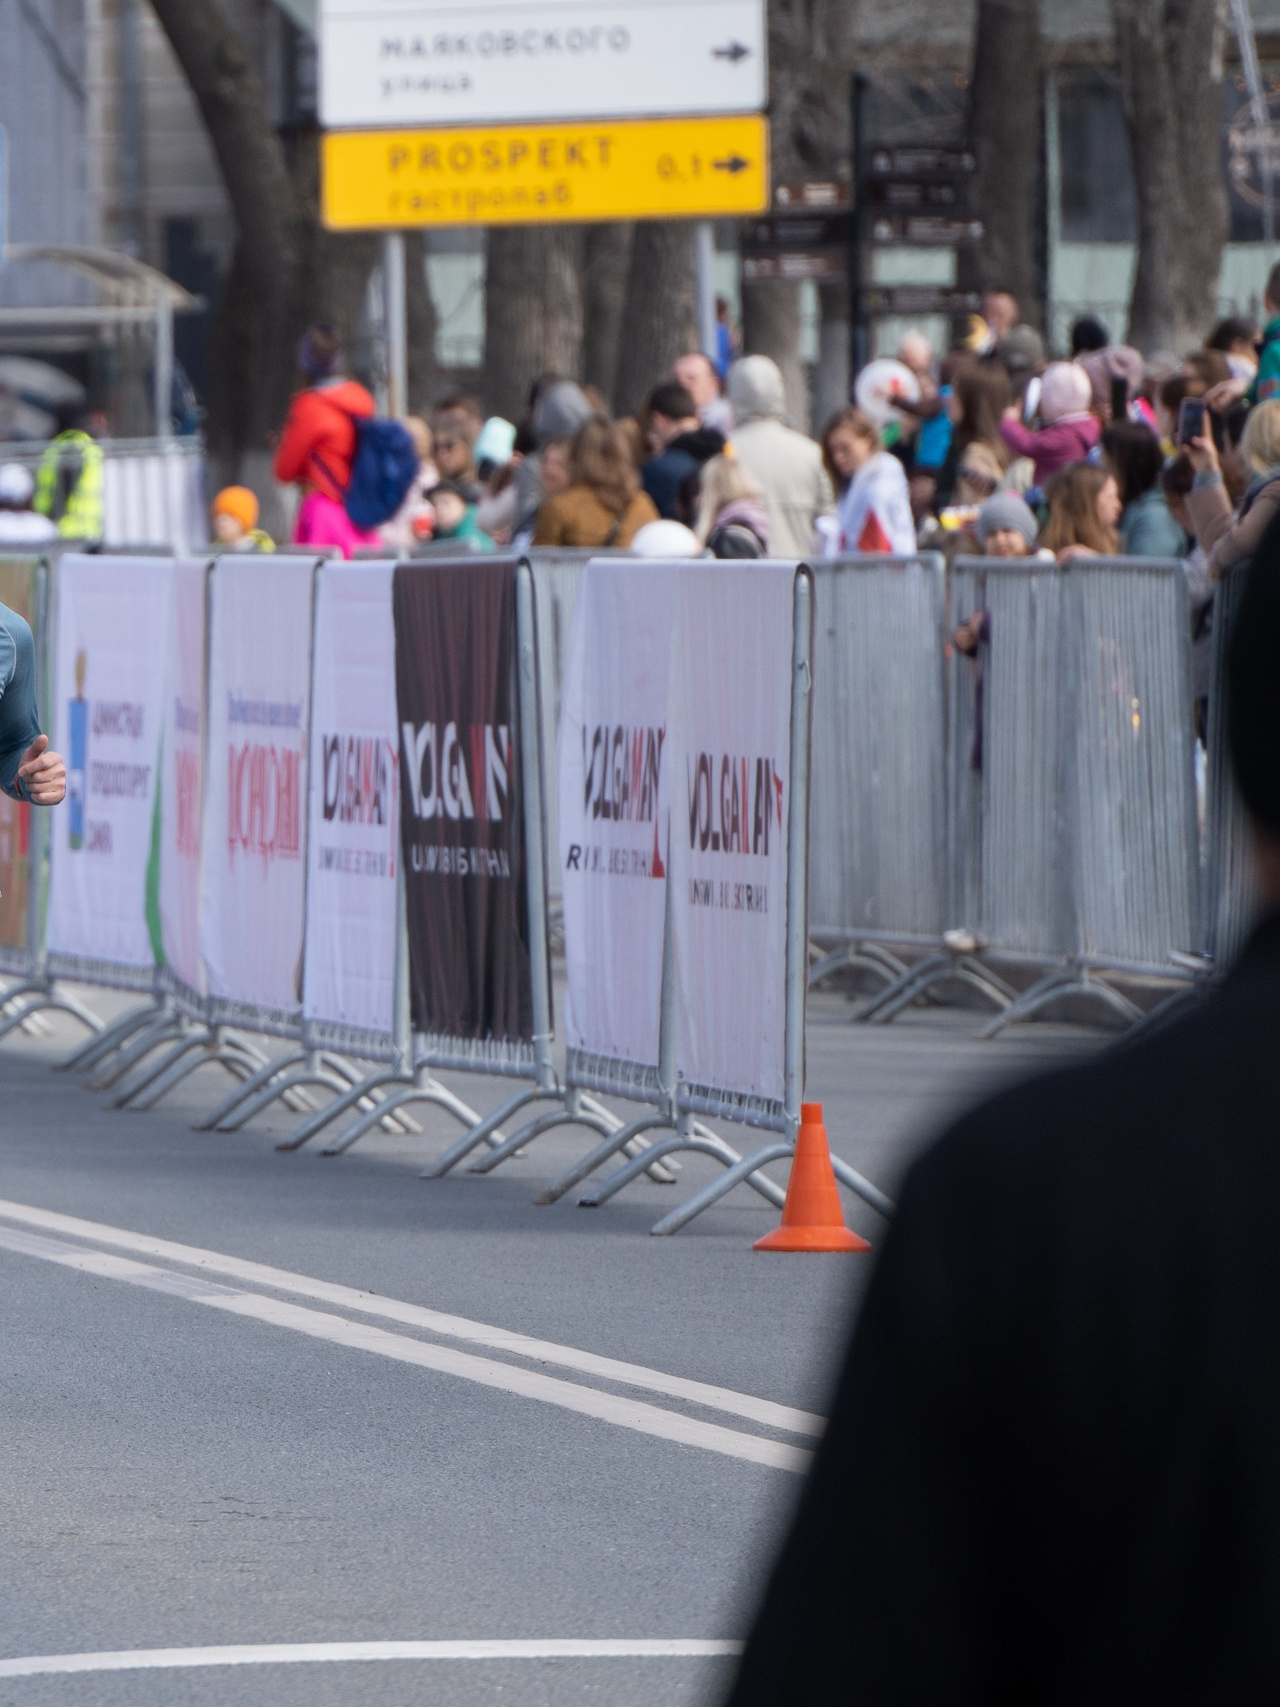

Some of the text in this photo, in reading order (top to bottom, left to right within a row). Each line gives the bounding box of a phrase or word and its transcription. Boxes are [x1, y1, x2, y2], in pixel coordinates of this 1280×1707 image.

[379, 26, 631, 62] МАЯКОВСКОГО
[380, 73, 474, 98] улица
[388, 136, 614, 173] PROSPEKT
